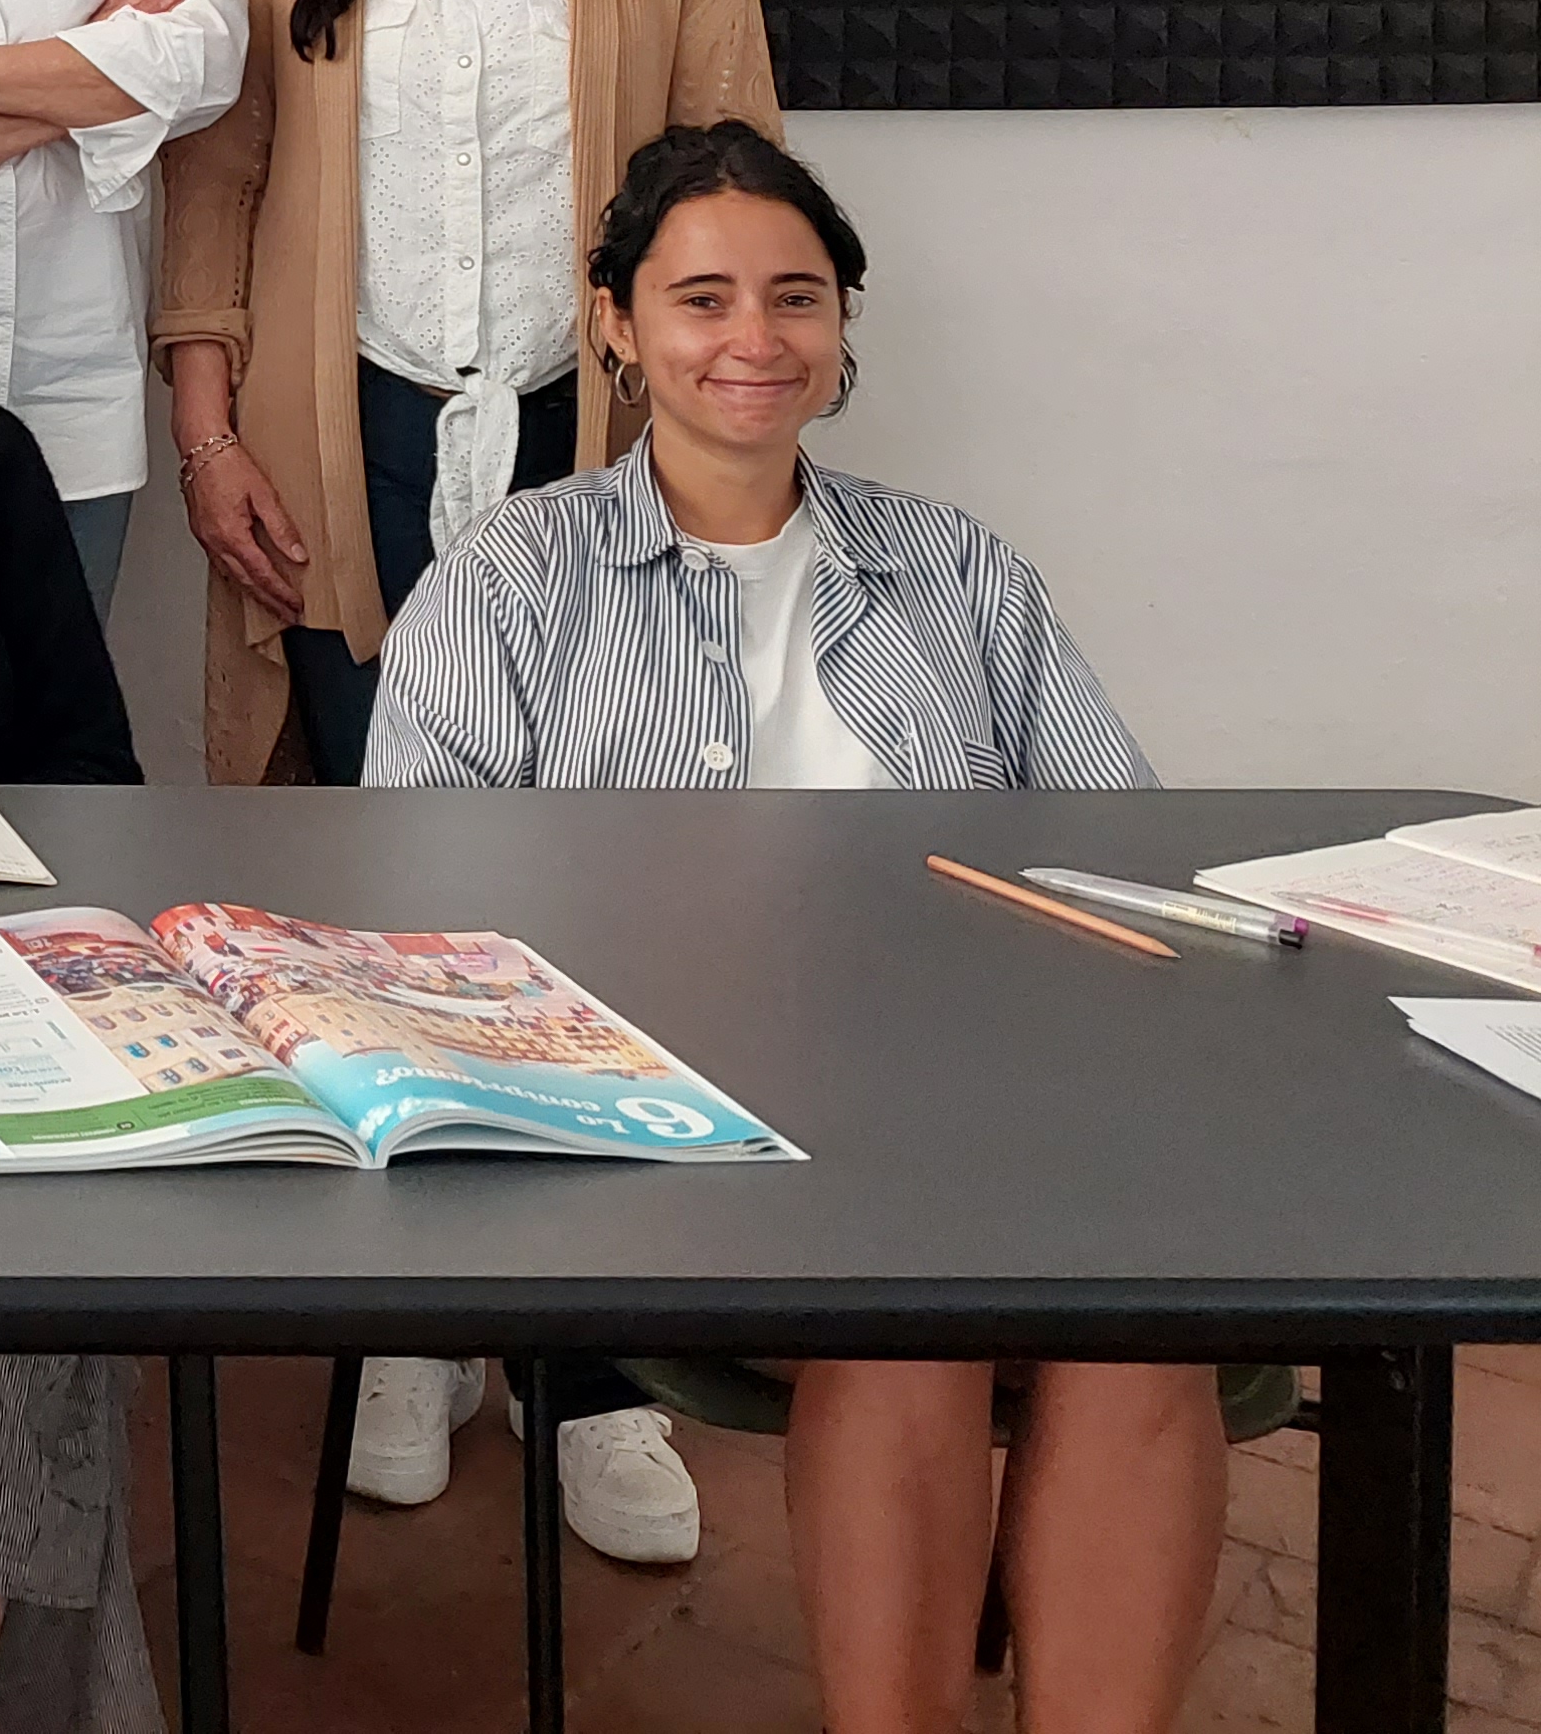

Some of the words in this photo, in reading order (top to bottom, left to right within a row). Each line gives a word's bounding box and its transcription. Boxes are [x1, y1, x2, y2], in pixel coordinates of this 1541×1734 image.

[375, 1065, 601, 1113] compriamo?
[576, 1114, 630, 1134] Lo
[616, 1097, 714, 1140] 6
